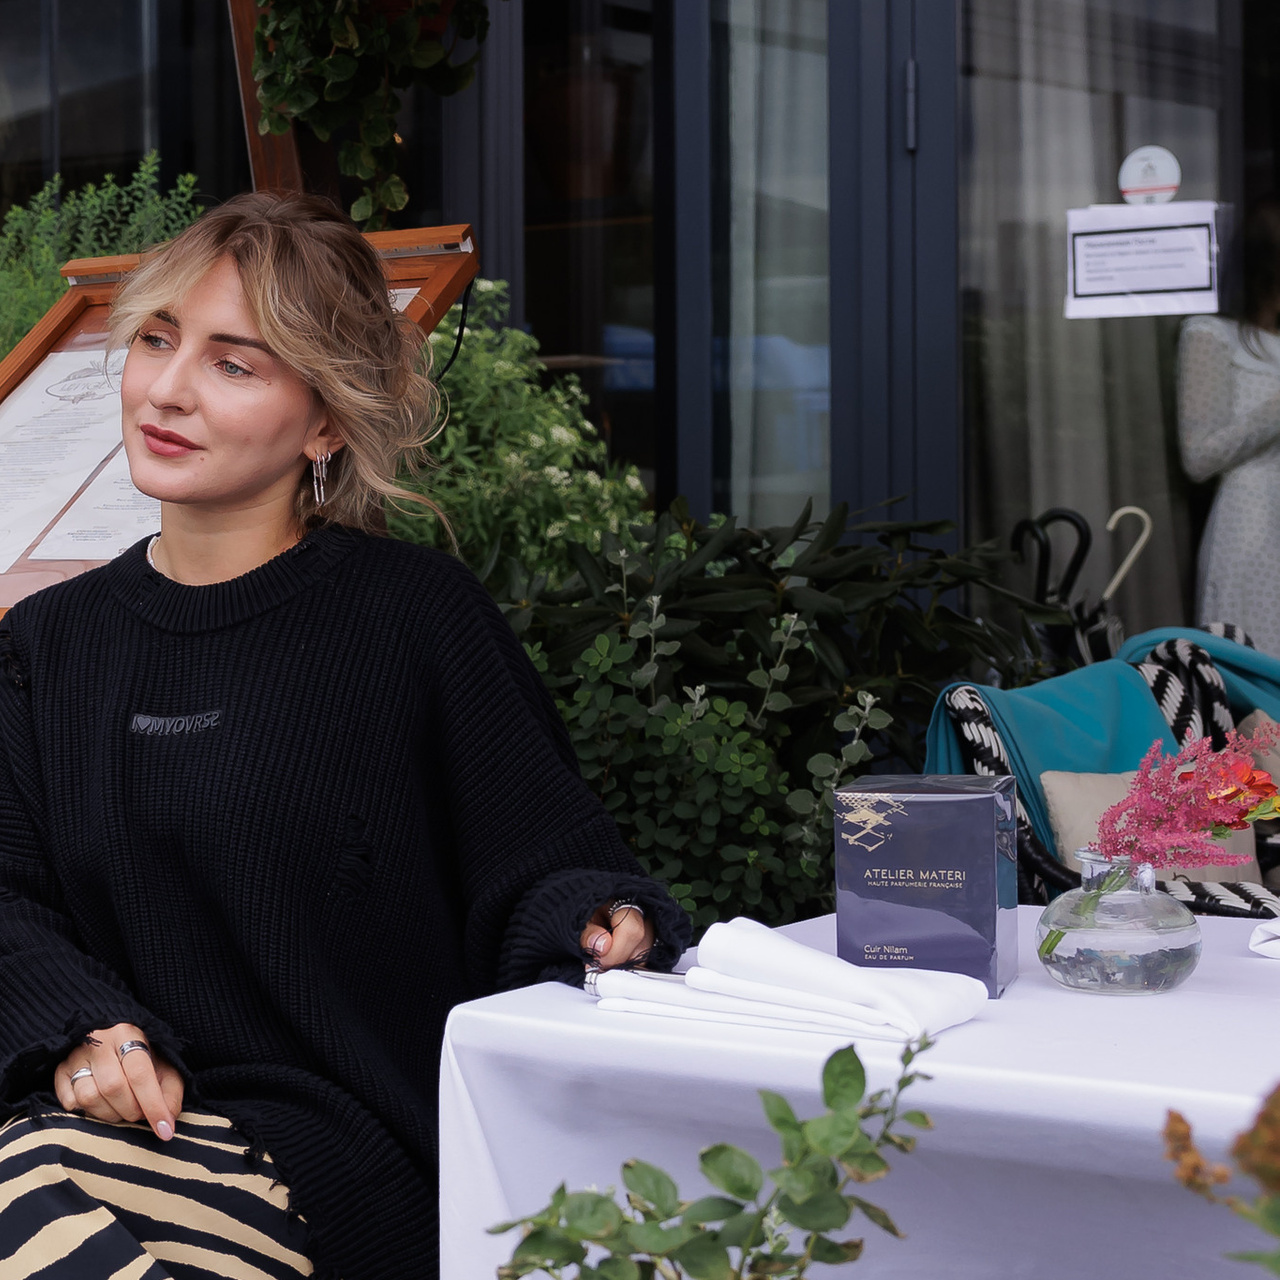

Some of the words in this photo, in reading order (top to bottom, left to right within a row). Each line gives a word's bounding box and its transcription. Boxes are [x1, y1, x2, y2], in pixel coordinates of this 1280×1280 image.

[863, 869, 915, 880] ATELIER
[919, 870, 966, 881] MATERI
[863, 944, 881, 953] Cuir
[883, 945, 908, 954] Nilam
